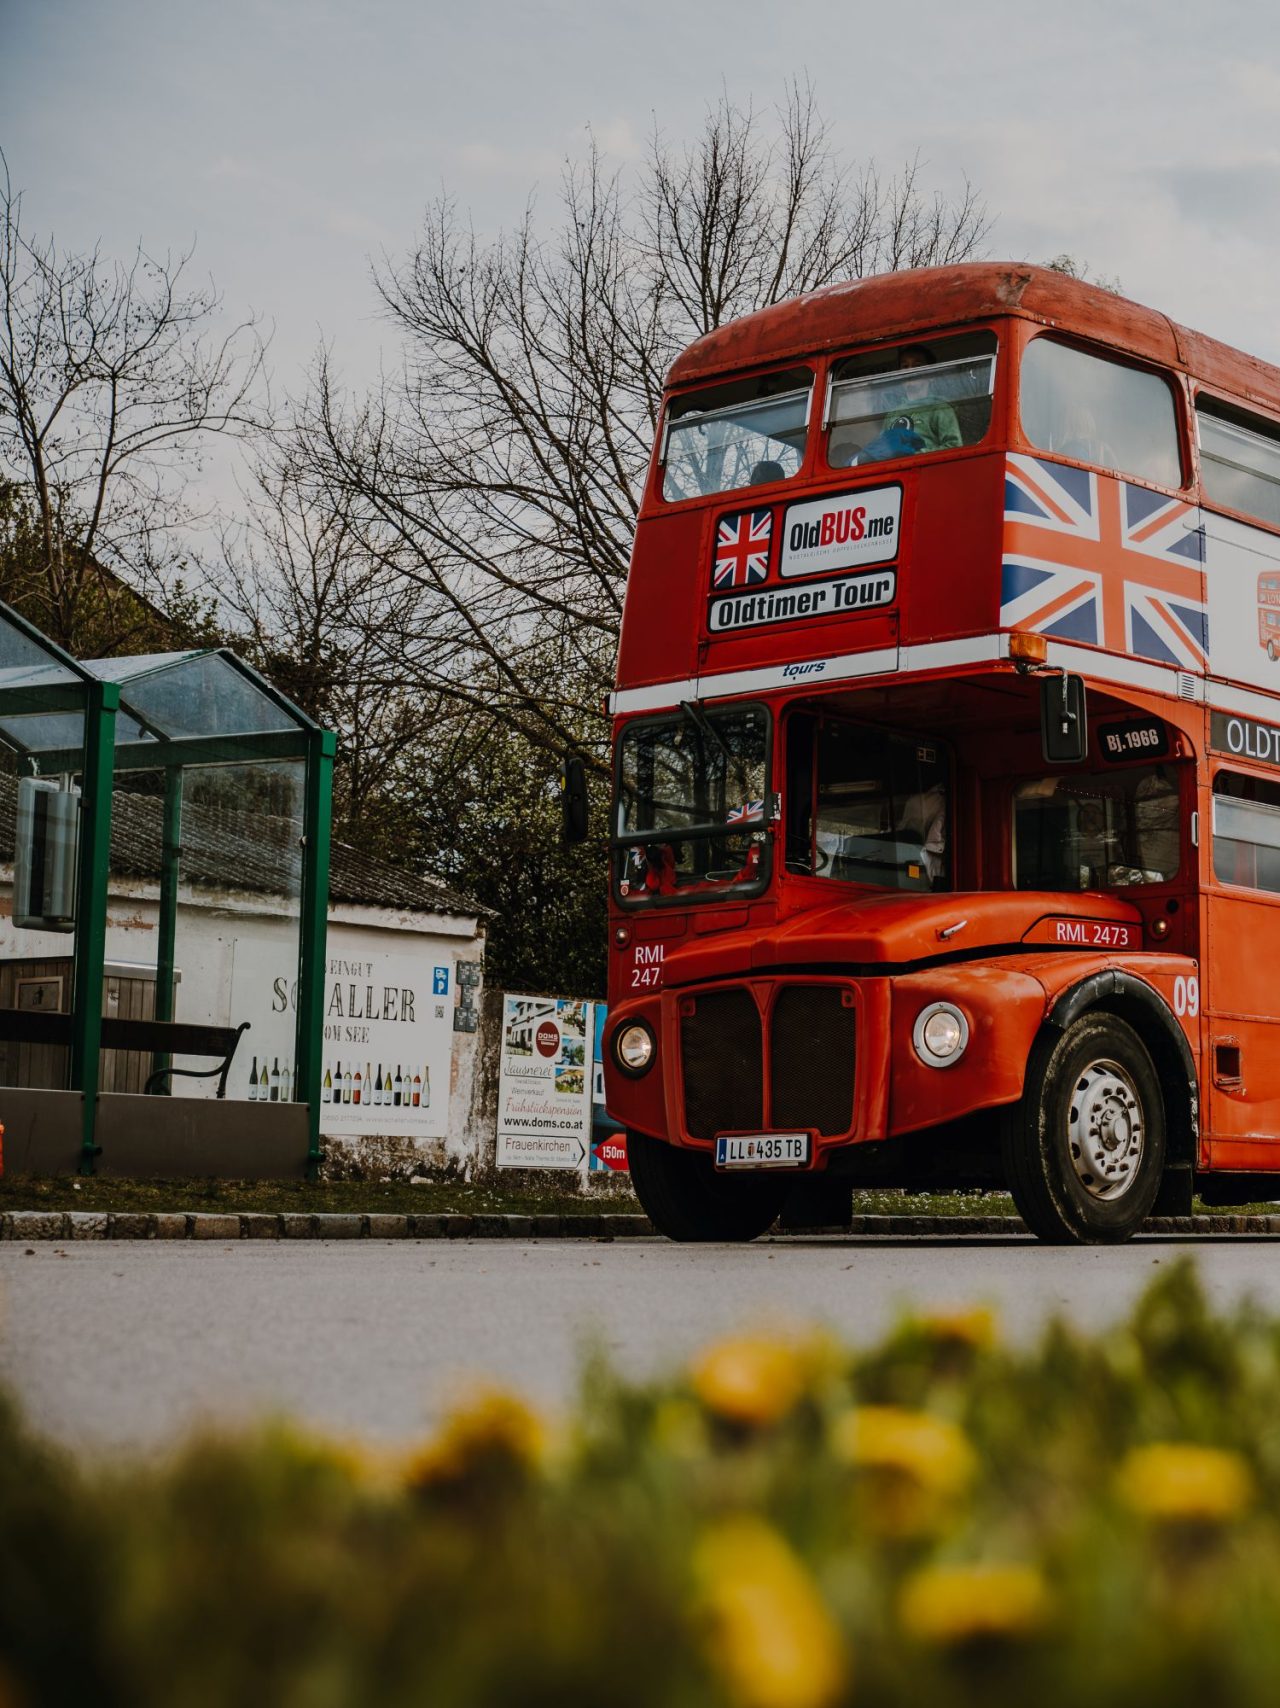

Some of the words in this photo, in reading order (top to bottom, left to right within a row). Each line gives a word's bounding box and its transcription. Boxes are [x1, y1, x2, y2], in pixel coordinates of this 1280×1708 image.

[790, 507, 894, 551] OldBUS.me
[718, 589, 826, 626] Oldtimer
[832, 579, 890, 608] Tour
[782, 661, 826, 677] tours
[1106, 729, 1159, 752] Bj.1966
[1056, 922, 1089, 942] RML
[1093, 925, 1129, 945] 2473
[635, 944, 664, 964] RML
[325, 959, 373, 977] EINGUT
[631, 967, 663, 987] 247
[272, 976, 416, 1022] SALLER
[1173, 975, 1199, 1017] 09
[324, 1025, 341, 1041] OM
[345, 1026, 370, 1043] SEE
[504, 1117, 583, 1130] www.doms.co.at
[505, 1137, 571, 1152] Frauenkirchen
[602, 1145, 625, 1159] 150m
[730, 1141, 745, 1160] LL
[756, 1140, 782, 1159] 435
[785, 1139, 802, 1158] TB
